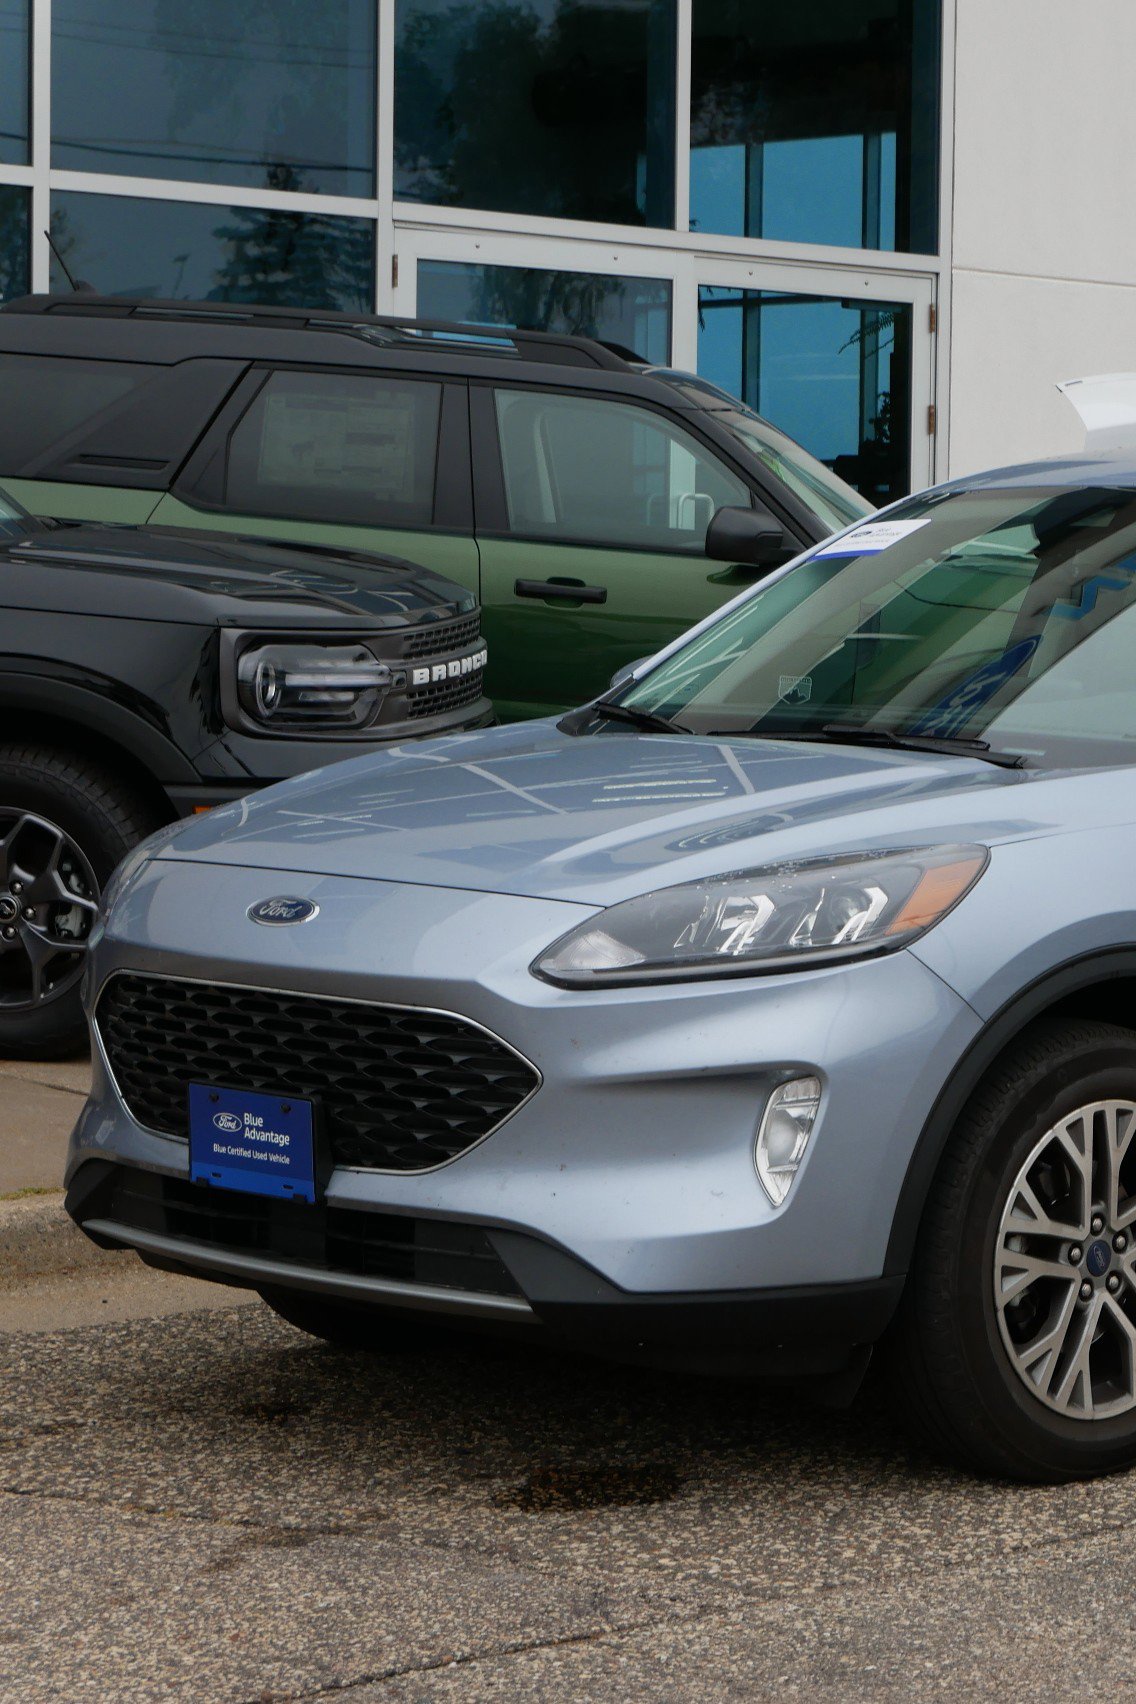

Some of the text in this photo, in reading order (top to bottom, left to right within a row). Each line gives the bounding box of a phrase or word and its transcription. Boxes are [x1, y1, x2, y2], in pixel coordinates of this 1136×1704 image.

[413, 649, 488, 685] BRONCO
[259, 899, 303, 918] Ford
[243, 1112, 263, 1127] Blue
[244, 1127, 290, 1147] Advantage
[213, 1143, 290, 1165] Blue Certified Used Vehicle
